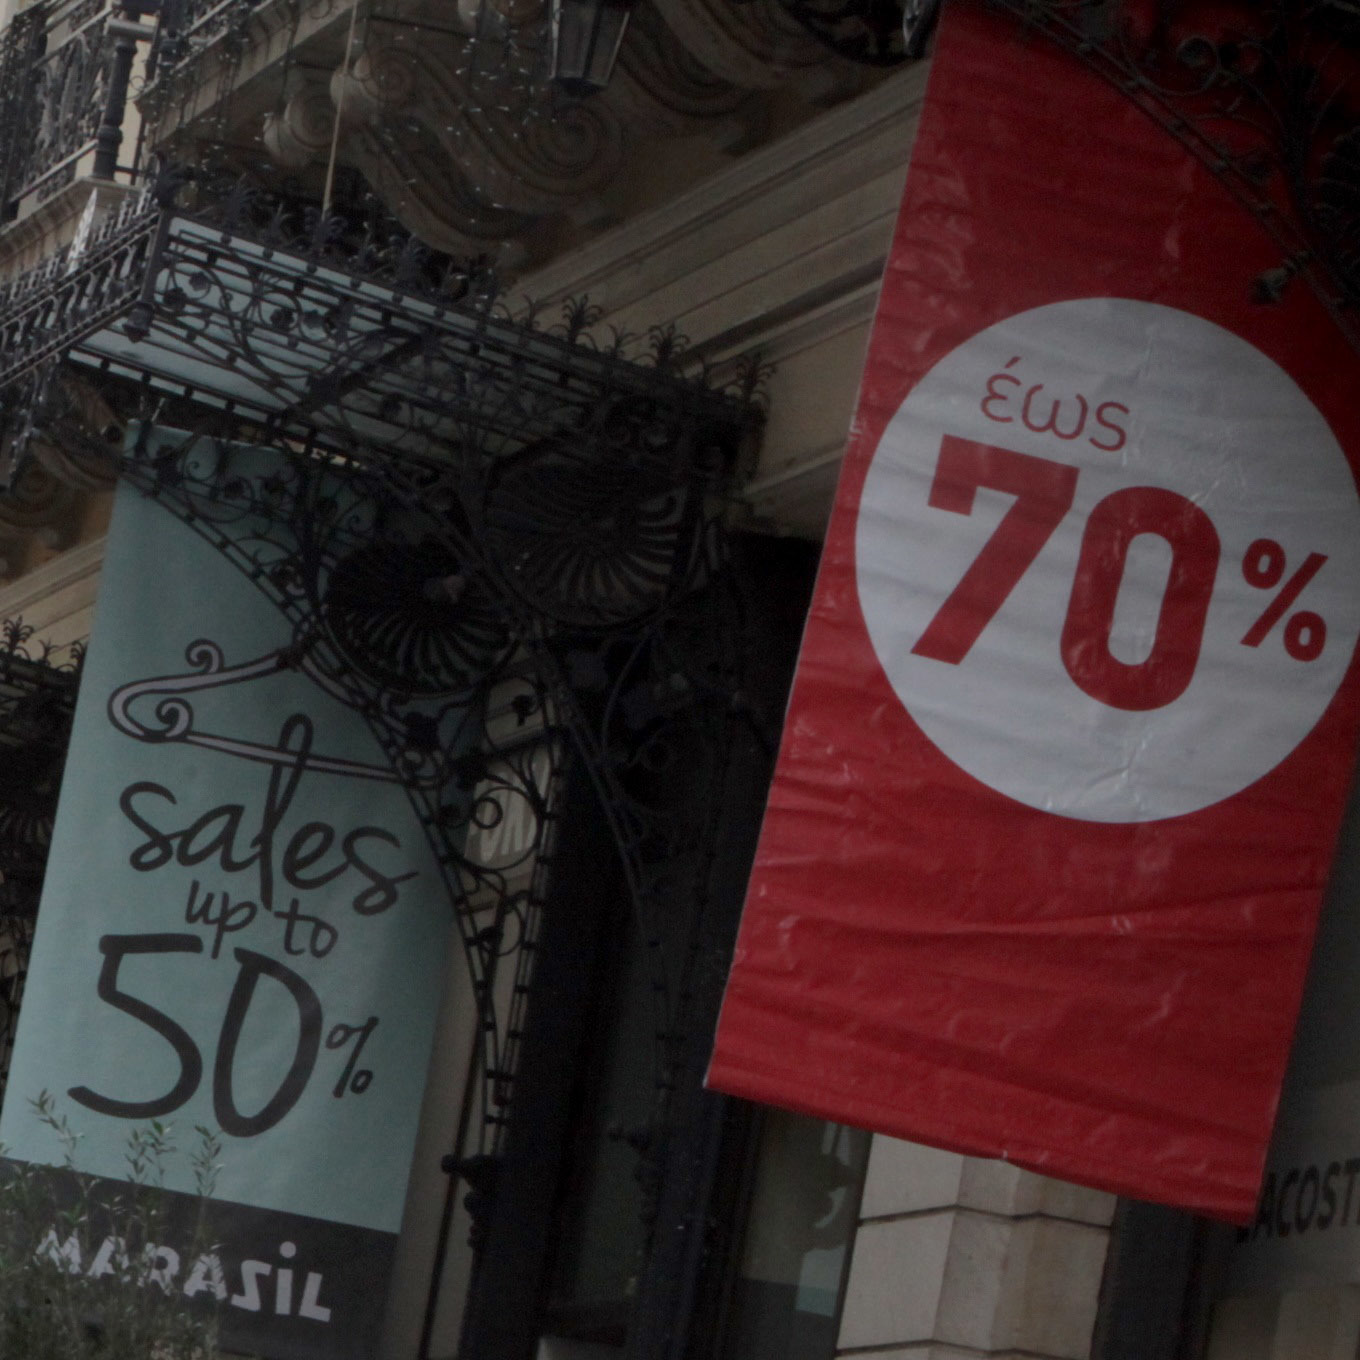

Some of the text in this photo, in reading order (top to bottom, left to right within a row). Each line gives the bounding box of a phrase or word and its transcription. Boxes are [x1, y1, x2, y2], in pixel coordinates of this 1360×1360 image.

[910, 433, 1329, 712] 70%
[119, 713, 419, 915] sales
[185, 880, 339, 960] up to
[67, 933, 379, 1138] 50%
